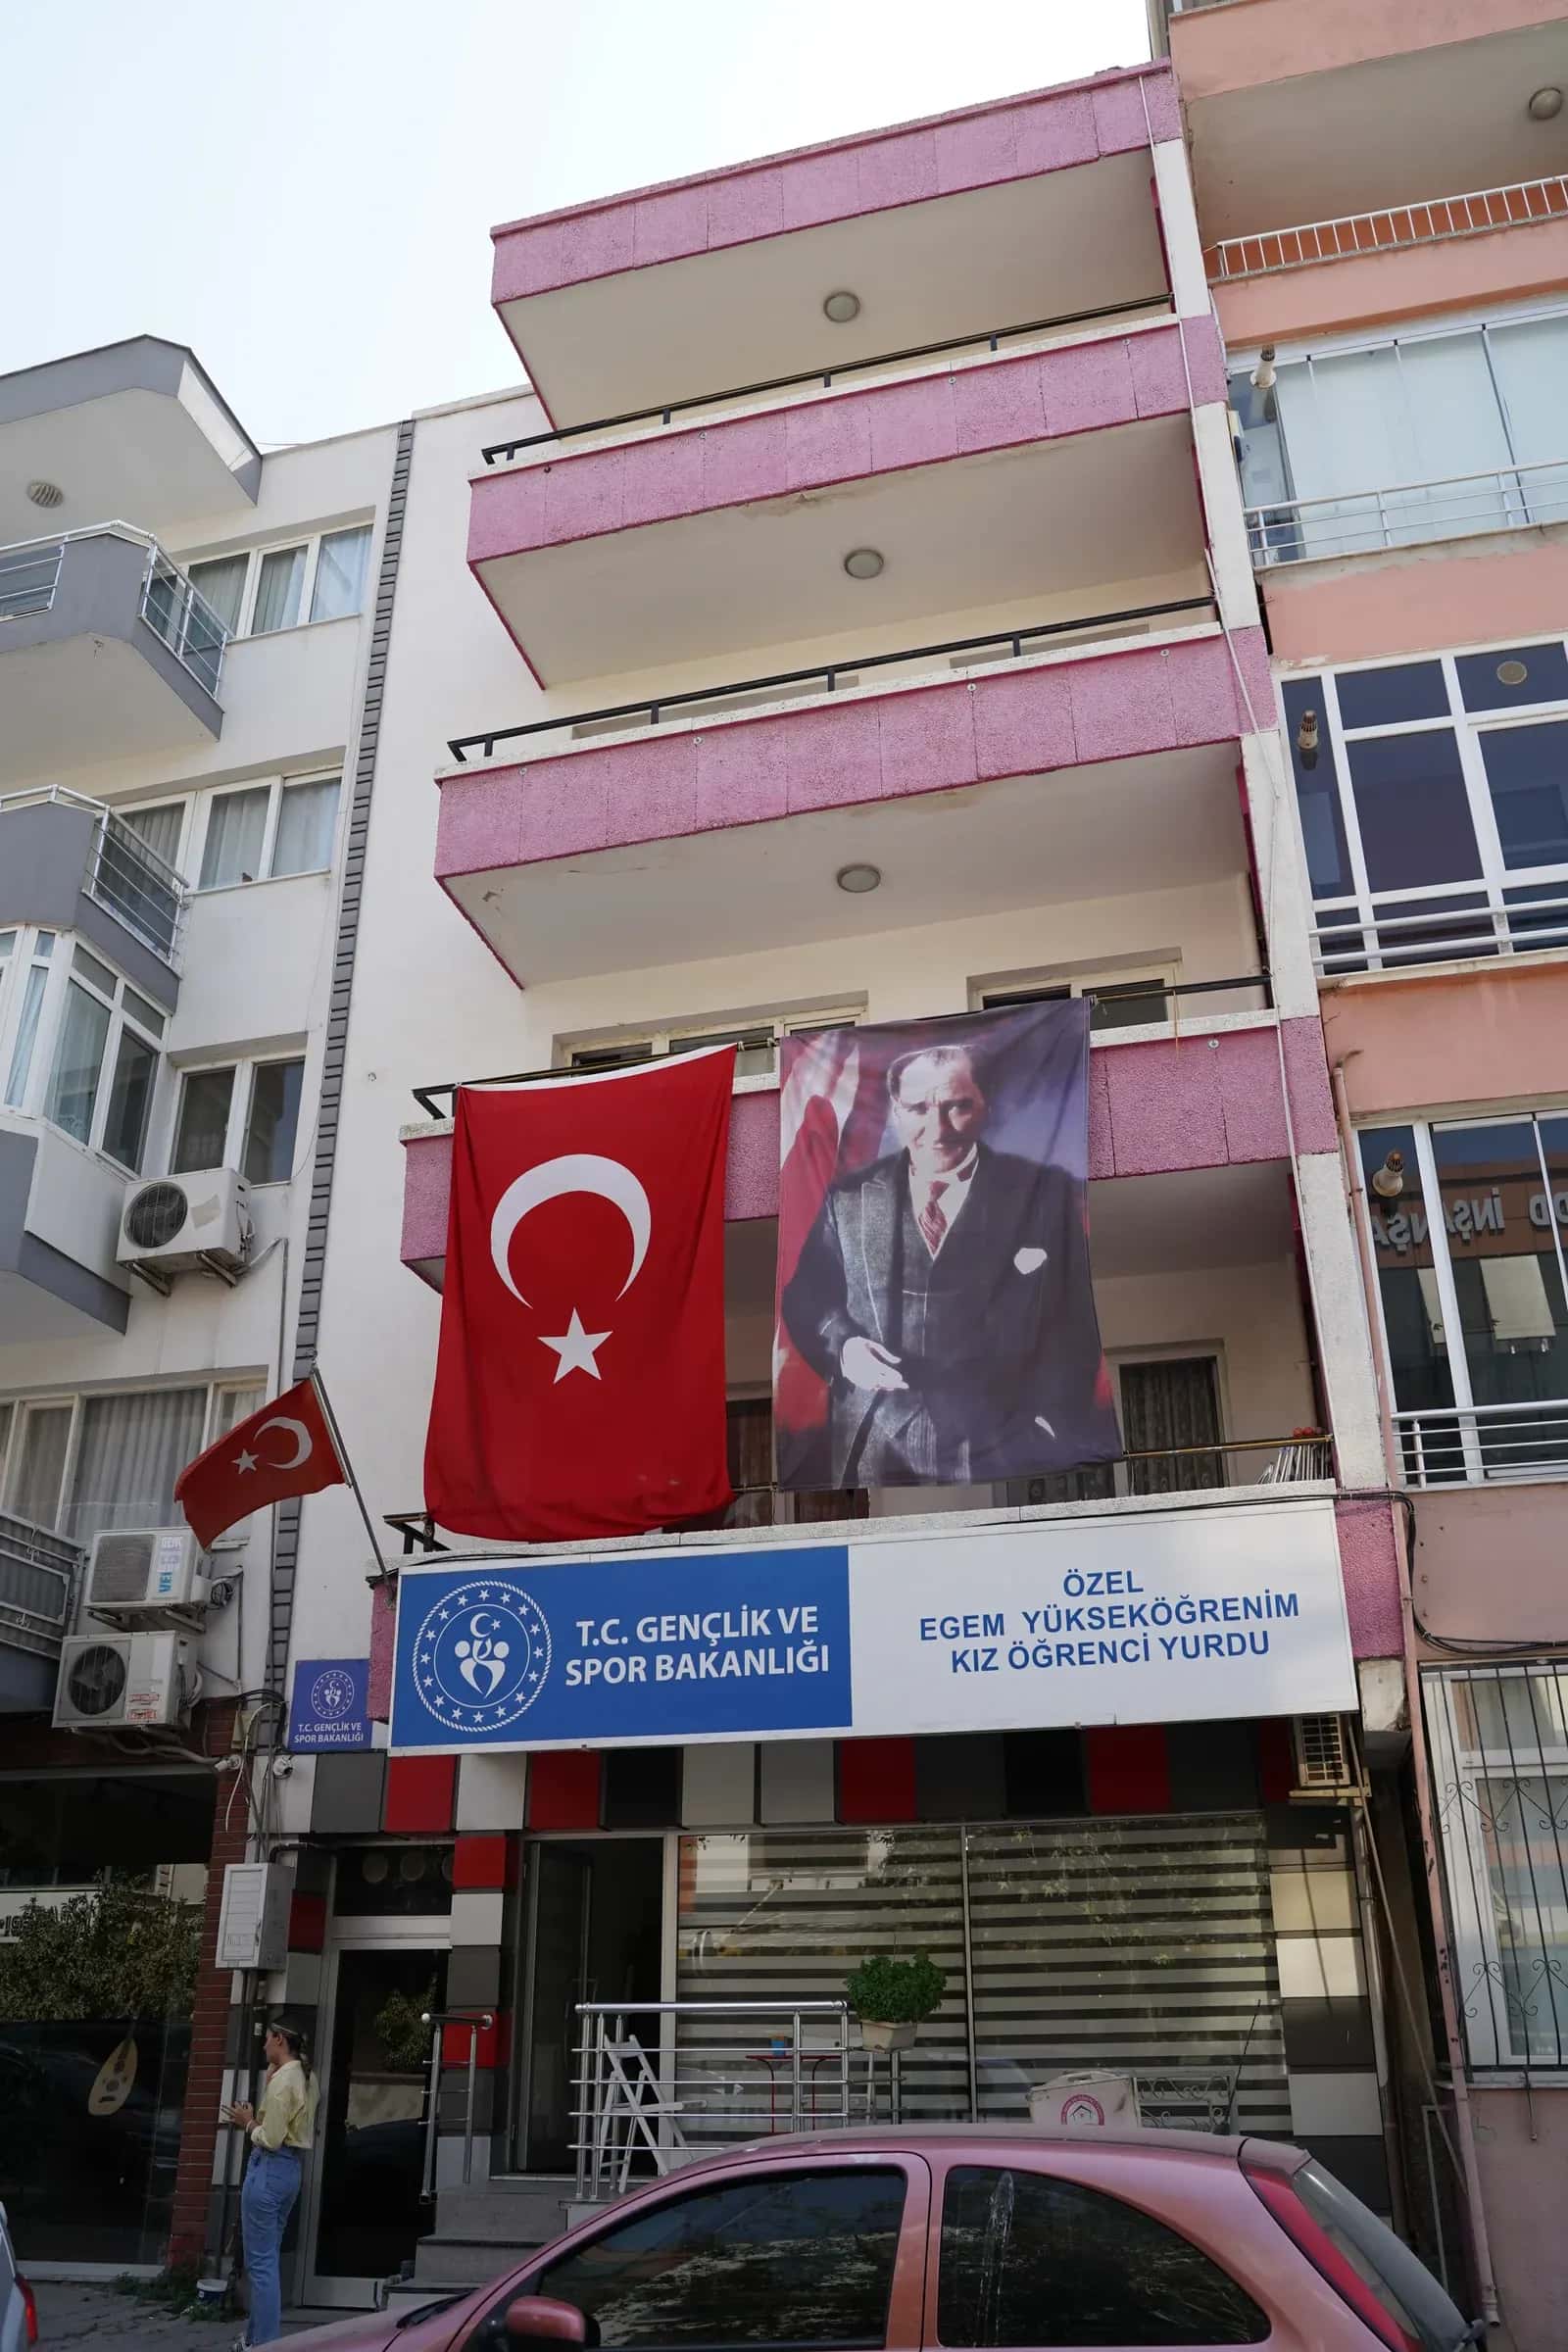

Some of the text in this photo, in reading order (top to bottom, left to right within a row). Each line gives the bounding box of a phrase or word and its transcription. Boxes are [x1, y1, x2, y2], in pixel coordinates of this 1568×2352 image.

[1062, 1568, 1145, 1597] ÖZEL
[576, 1604, 818, 1647] T.C. GENÇLİK VE
[919, 1589, 1299, 1642] EGEM YÜKSEKÖĞRENİM
[565, 1640, 829, 1687] SPOR BAKANLIĞI
[951, 1630, 1270, 1674] KIZ ÖĞRENCİ YURDU
[294, 1733, 364, 1743] SPOR BAKANLIĞI
[298, 1722, 362, 1733] T.C. GENÇLİK VE
